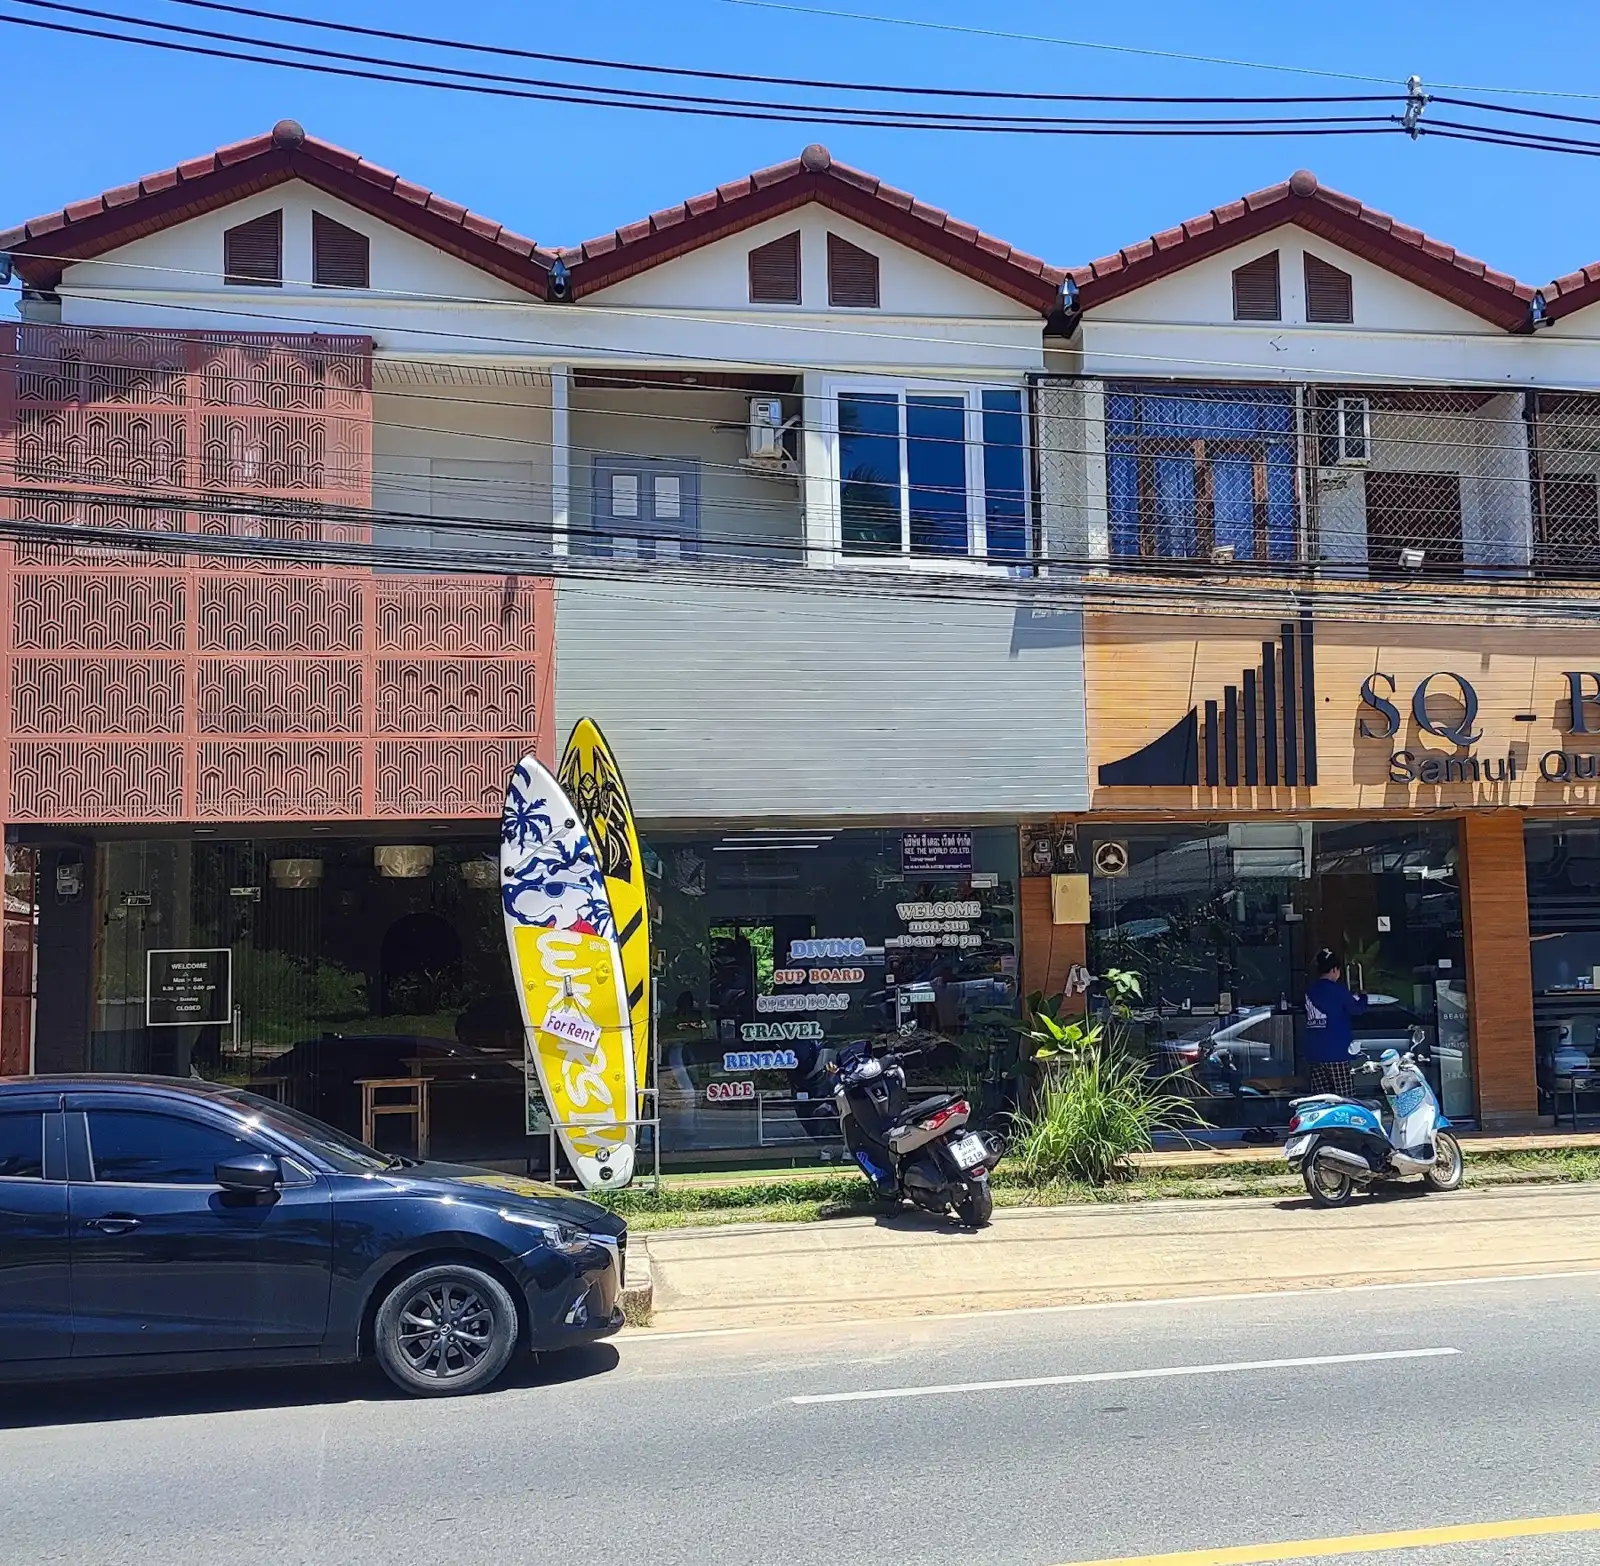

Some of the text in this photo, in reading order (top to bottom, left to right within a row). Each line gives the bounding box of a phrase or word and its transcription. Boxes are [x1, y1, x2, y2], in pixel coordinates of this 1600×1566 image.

[1360, 672, 1484, 746] SQ
[1389, 750, 1517, 784] Samui
[897, 901, 981, 919] WELCOME
[790, 938, 865, 958] DIVING
[898, 935, 912, 947] 10
[913, 936, 935, 947] am
[942, 934, 958, 946] 20
[960, 935, 982, 948] pm
[774, 968, 864, 984] SUP BOARD
[547, 1015, 595, 1042] For Rent
[740, 1021, 824, 1041] TRAVEL
[723, 1050, 798, 1071] RENTAL
[707, 1081, 755, 1101] SALE
